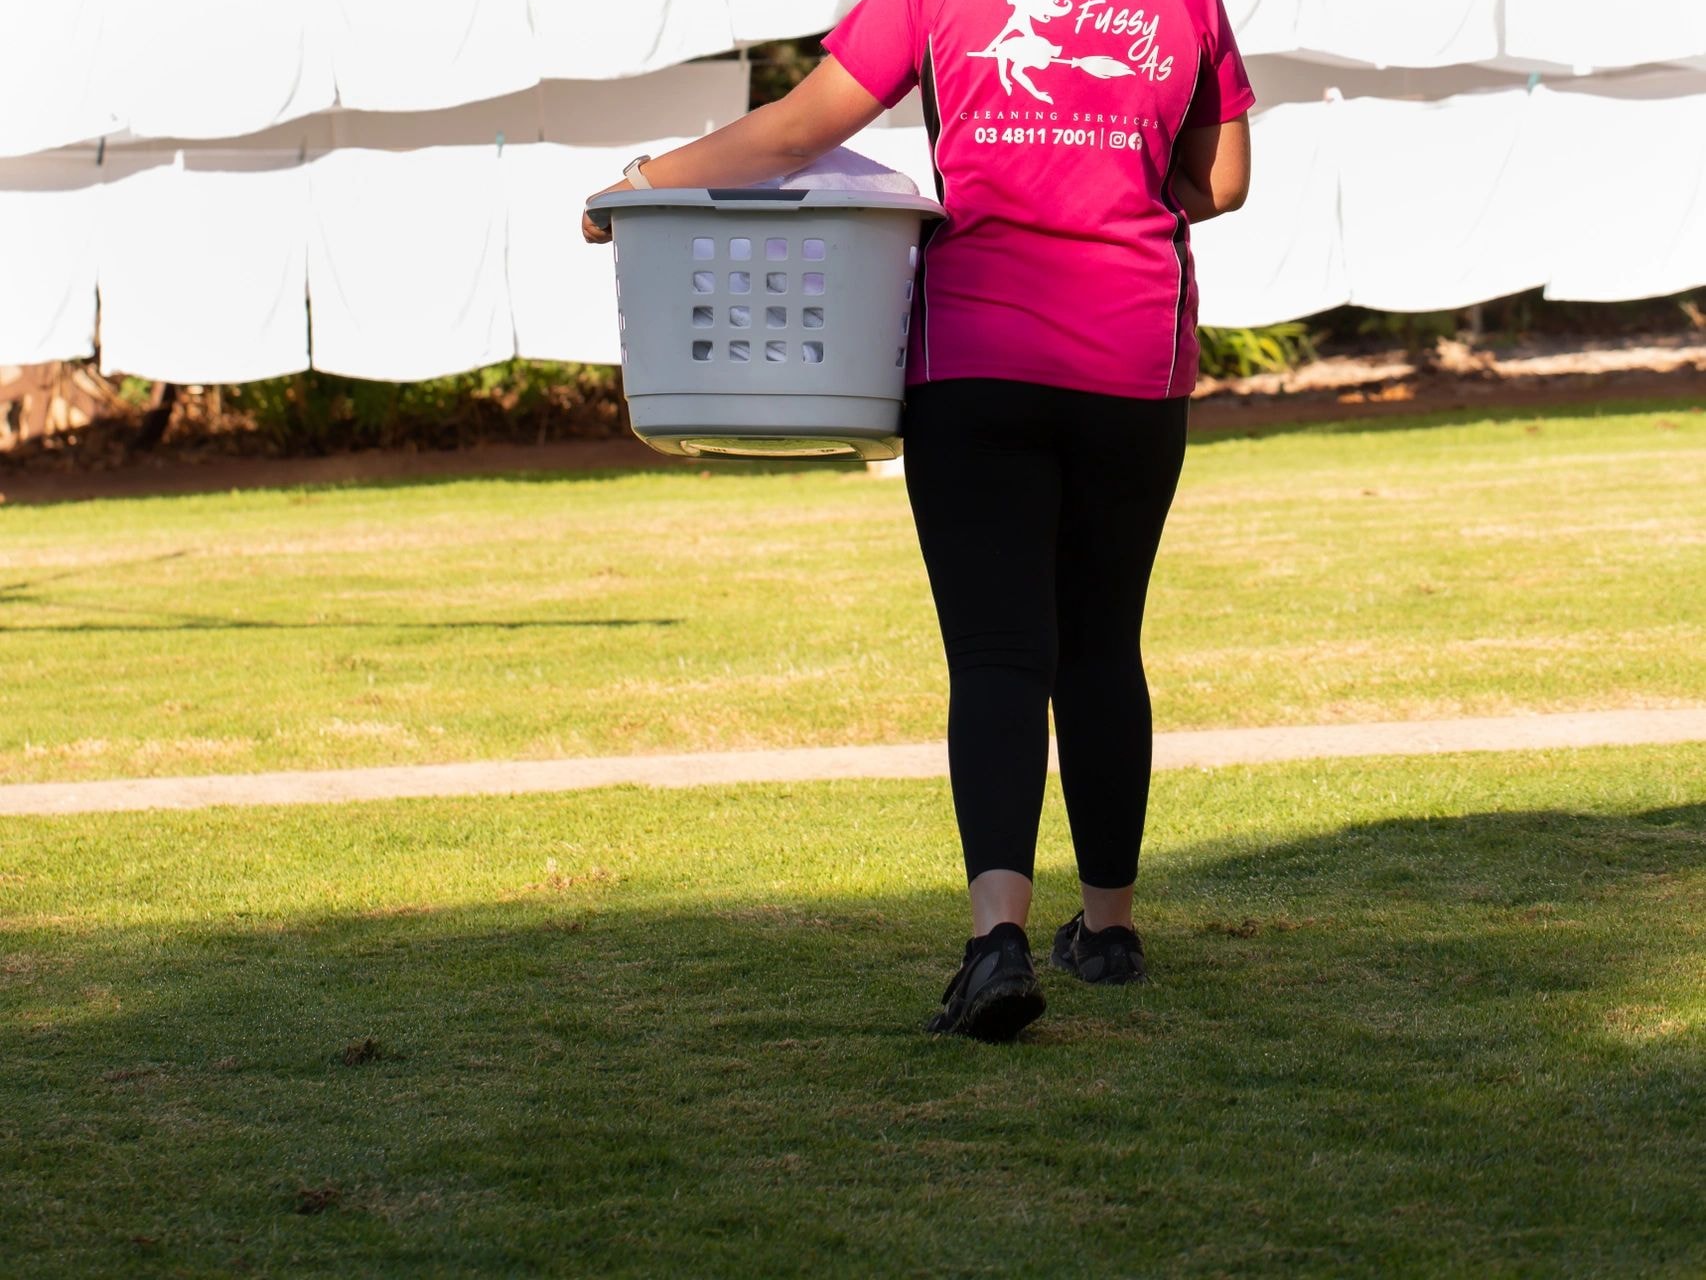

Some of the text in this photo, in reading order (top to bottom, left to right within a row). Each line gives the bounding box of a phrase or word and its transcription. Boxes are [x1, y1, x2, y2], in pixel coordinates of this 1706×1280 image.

[1138, 45, 1175, 81] As
[960, 110, 1159, 129] CLEANING SERVICES
[974, 127, 1096, 147] 03 4811 7001
